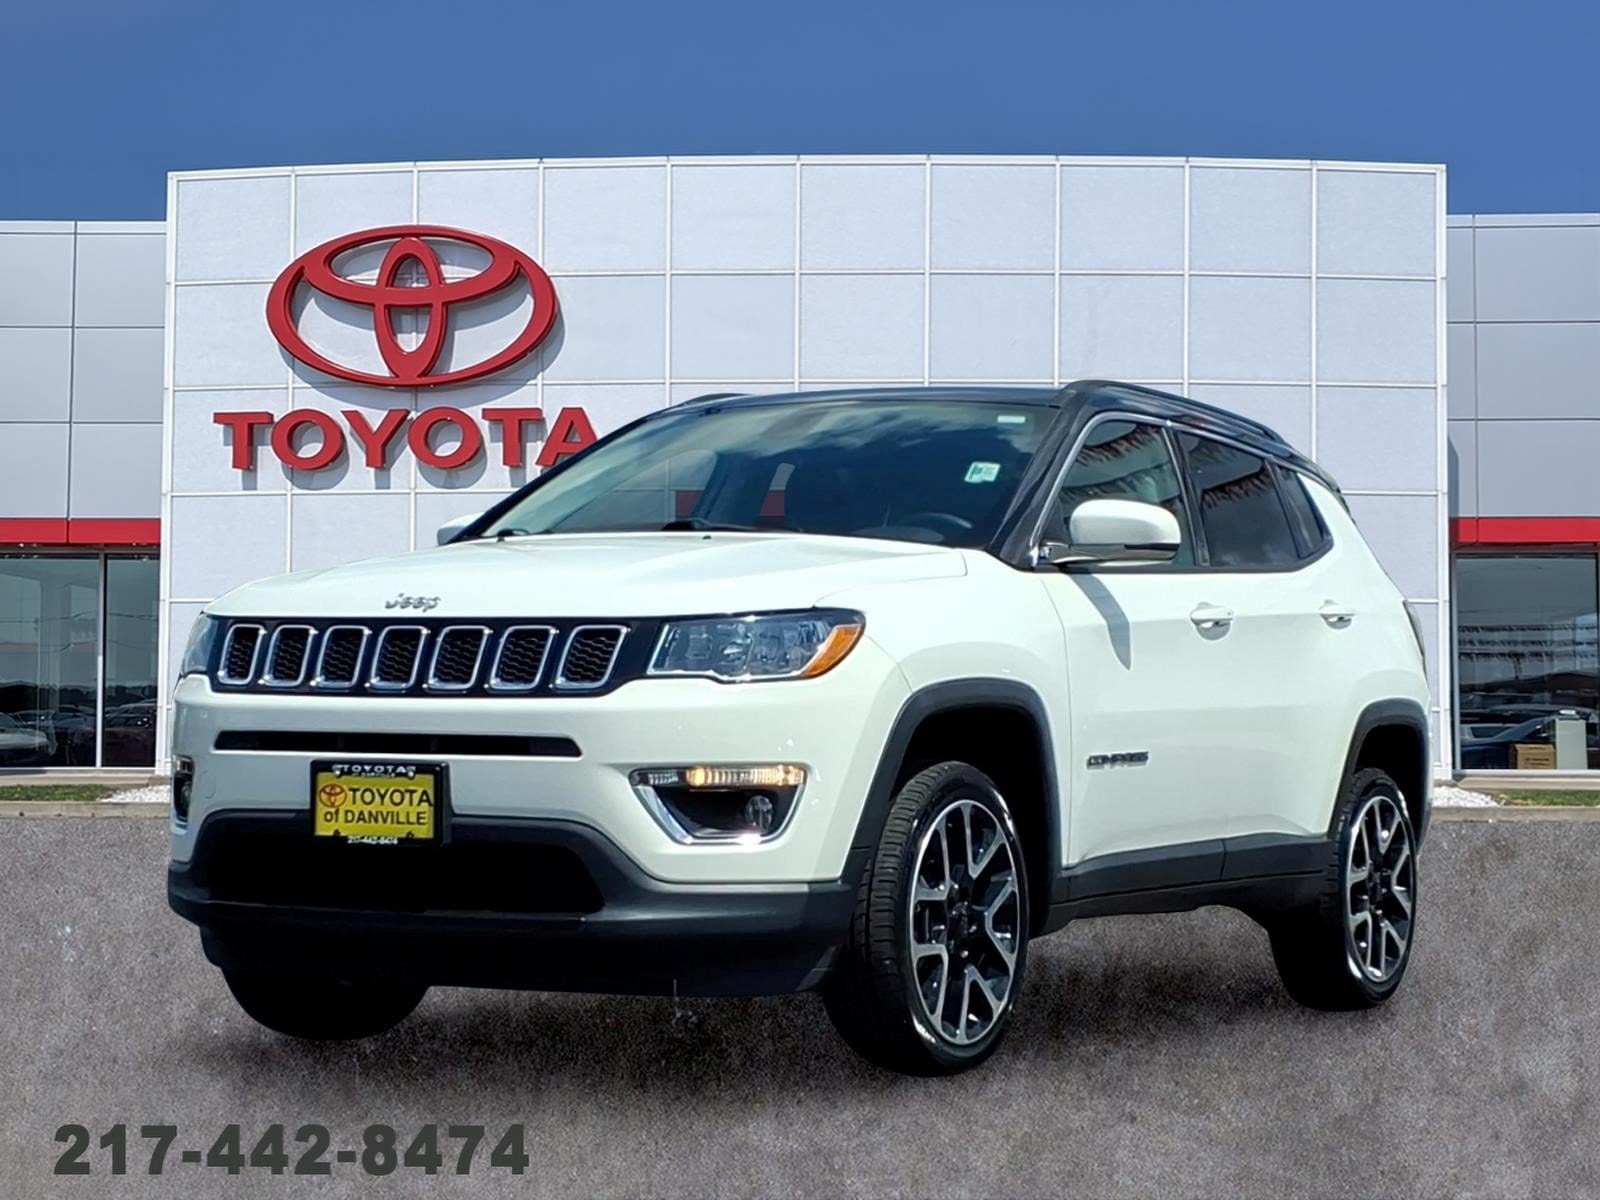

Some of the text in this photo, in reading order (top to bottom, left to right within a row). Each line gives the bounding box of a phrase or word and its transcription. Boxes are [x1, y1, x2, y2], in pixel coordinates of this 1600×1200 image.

[213, 406, 598, 470] TOYOTA
[385, 593, 441, 612] Jeep
[343, 764, 407, 773] TOYOTA
[348, 788, 433, 807] TOYOTA
[324, 808, 427, 825] of DANVILLE
